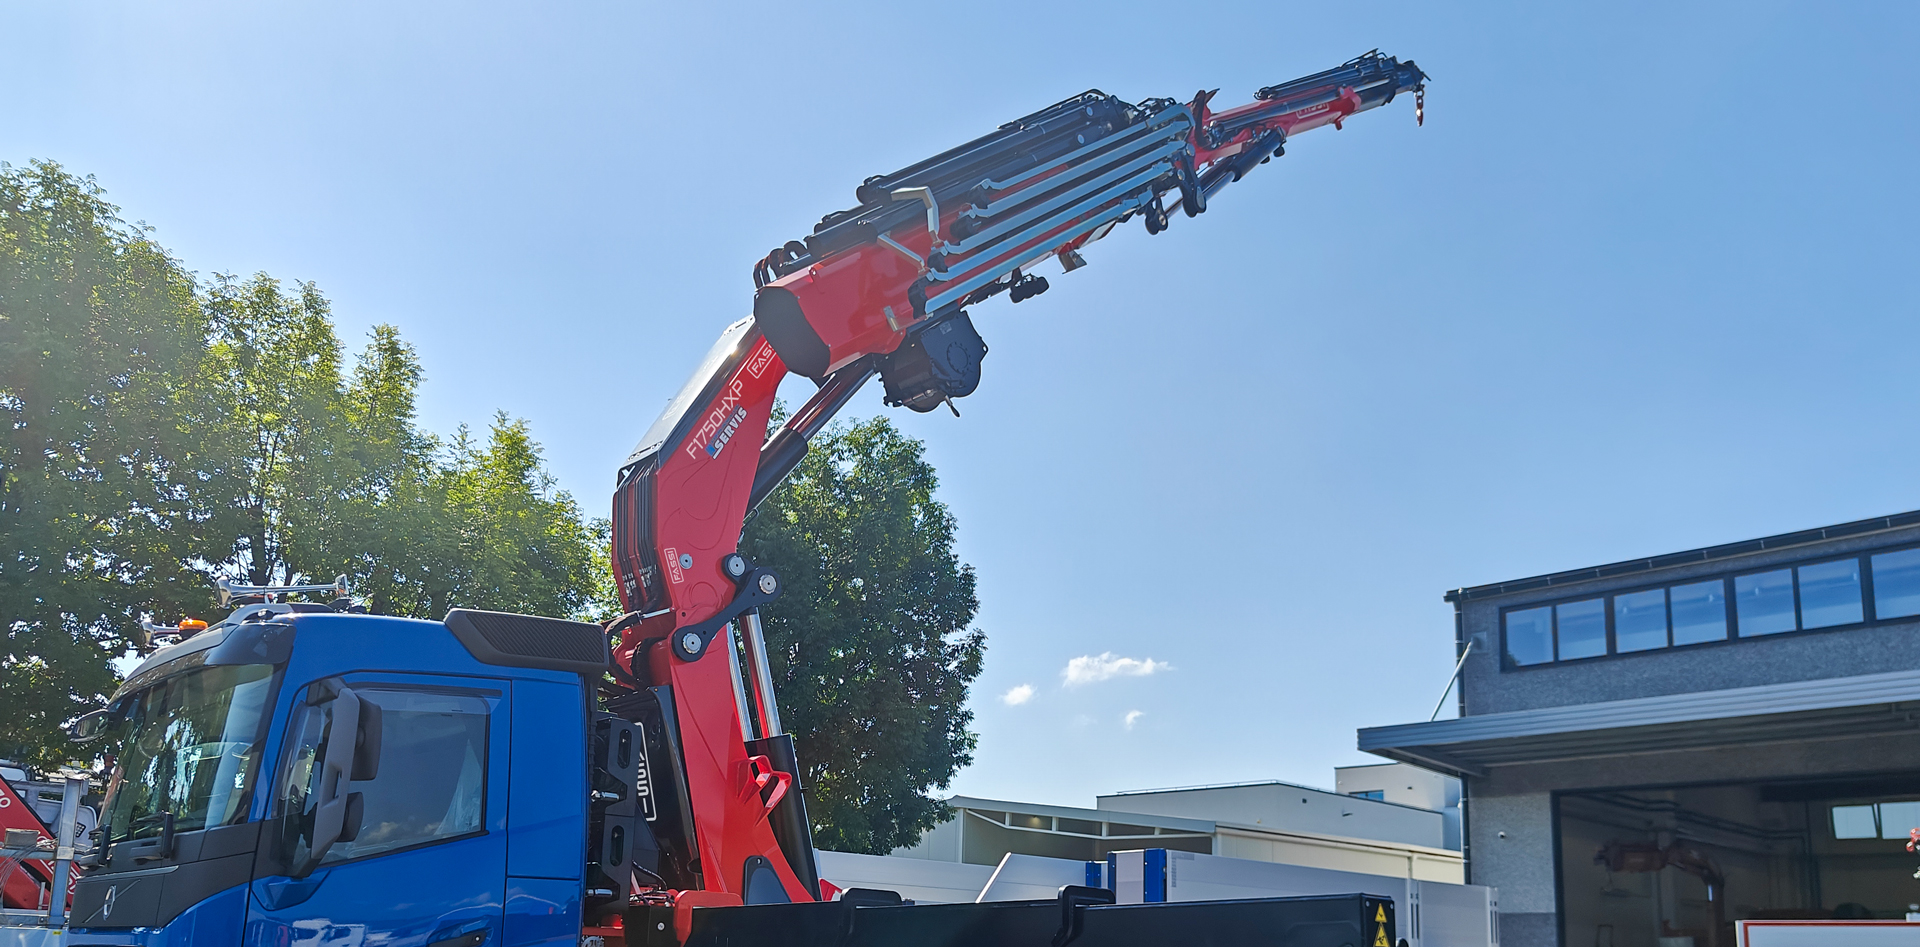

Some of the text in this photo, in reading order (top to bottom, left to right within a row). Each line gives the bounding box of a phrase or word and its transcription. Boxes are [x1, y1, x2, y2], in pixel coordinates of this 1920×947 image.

[686, 380, 743, 460] F1750HXP
[712, 406, 748, 460] SERVIS
[667, 550, 681, 581] FASSI
